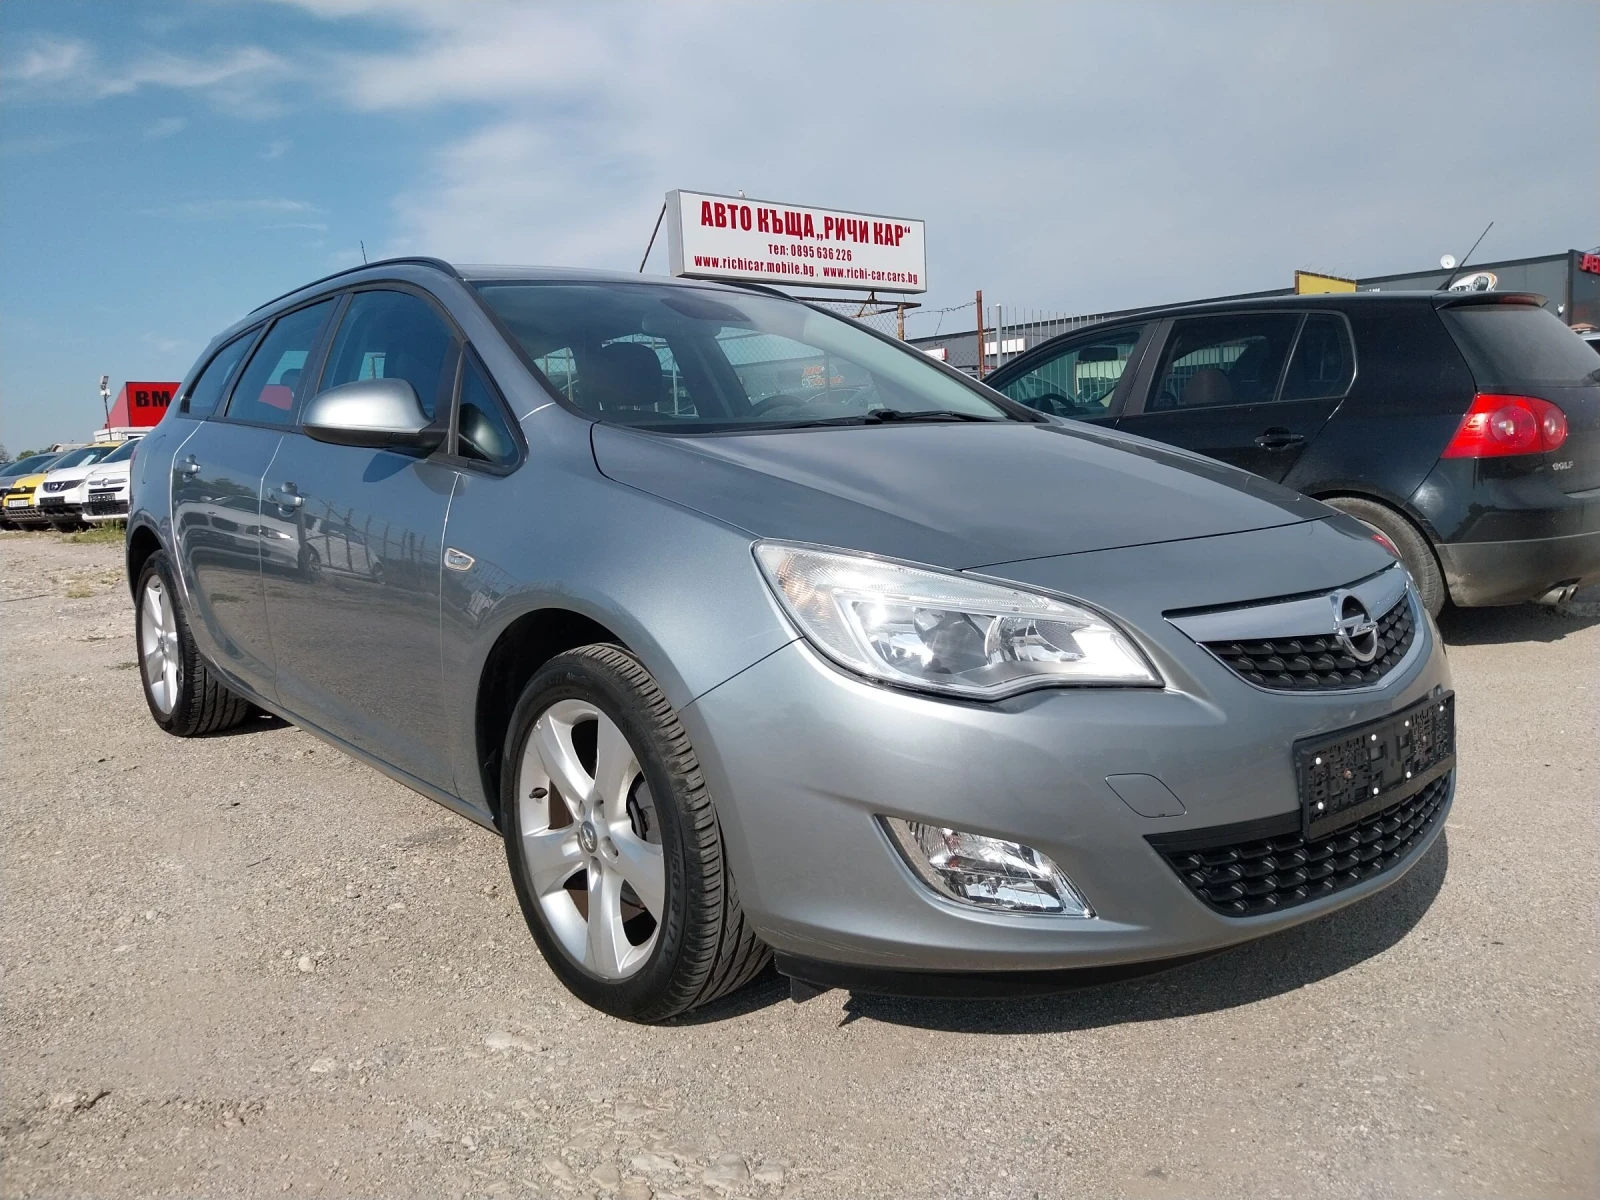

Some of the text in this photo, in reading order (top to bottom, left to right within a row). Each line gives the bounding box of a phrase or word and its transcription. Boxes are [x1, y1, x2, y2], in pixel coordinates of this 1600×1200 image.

[701, 201, 752, 231] АВТО
[757, 208, 815, 240] КЪЩА
[768, 244, 852, 261] тел: 0895 636 226
[823, 266, 918, 285] www.richi-car.cars.bg
[1552, 460, 1574, 471] GOLF
